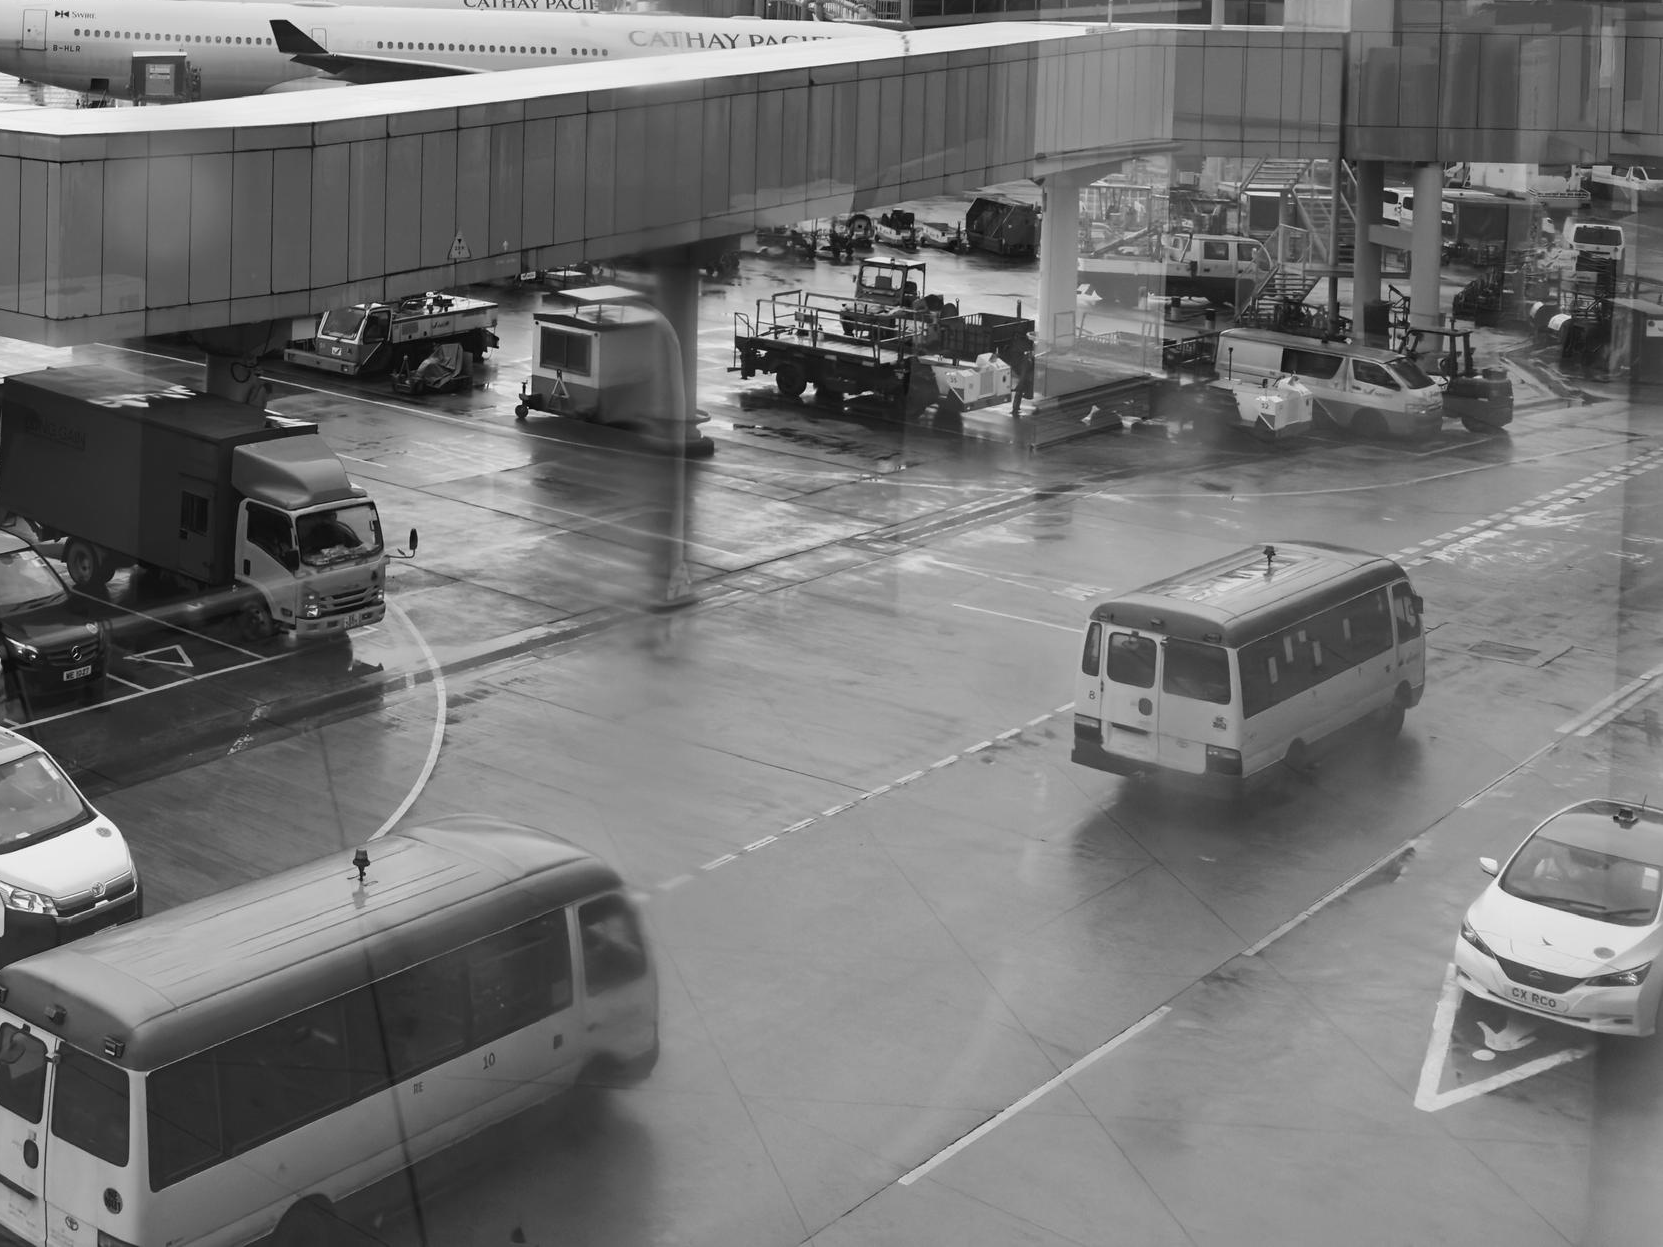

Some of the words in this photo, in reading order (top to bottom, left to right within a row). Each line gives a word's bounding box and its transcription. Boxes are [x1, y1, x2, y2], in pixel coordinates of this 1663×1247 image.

[628, 30, 740, 50] CATHAY
[52, 44, 81, 52] B-HLR
[1511, 987, 1527, 1000] CX
[482, 1052, 496, 1070] 10
